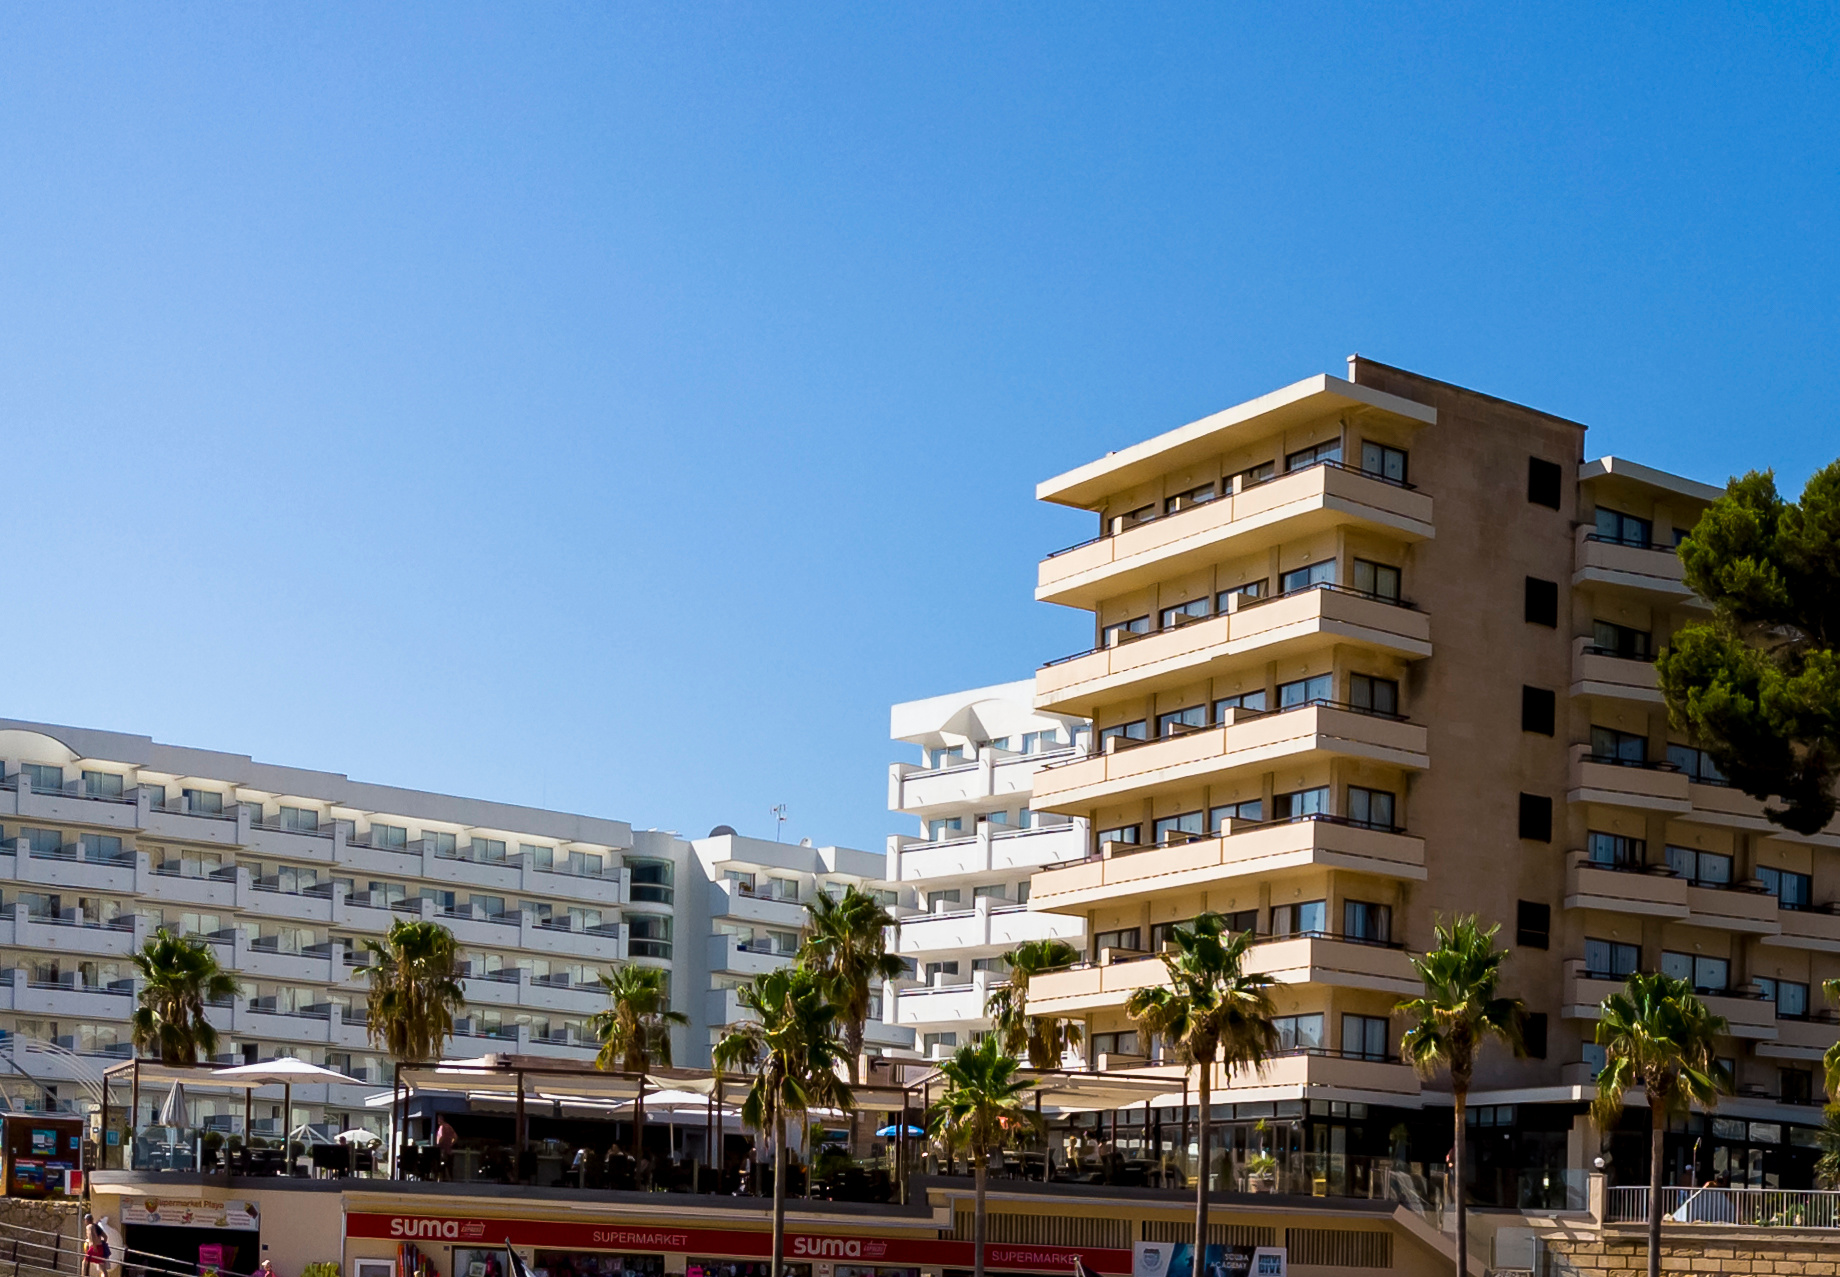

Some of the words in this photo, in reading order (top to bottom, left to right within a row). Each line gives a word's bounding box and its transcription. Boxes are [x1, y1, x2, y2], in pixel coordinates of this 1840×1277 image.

[390, 1218, 459, 1238] suma
[593, 1230, 688, 1246] SUPERMARKET
[793, 1236, 861, 1257] suma
[992, 1250, 1083, 1265] SUPERMARKET
[1210, 1261, 1247, 1269] ACADEMY
